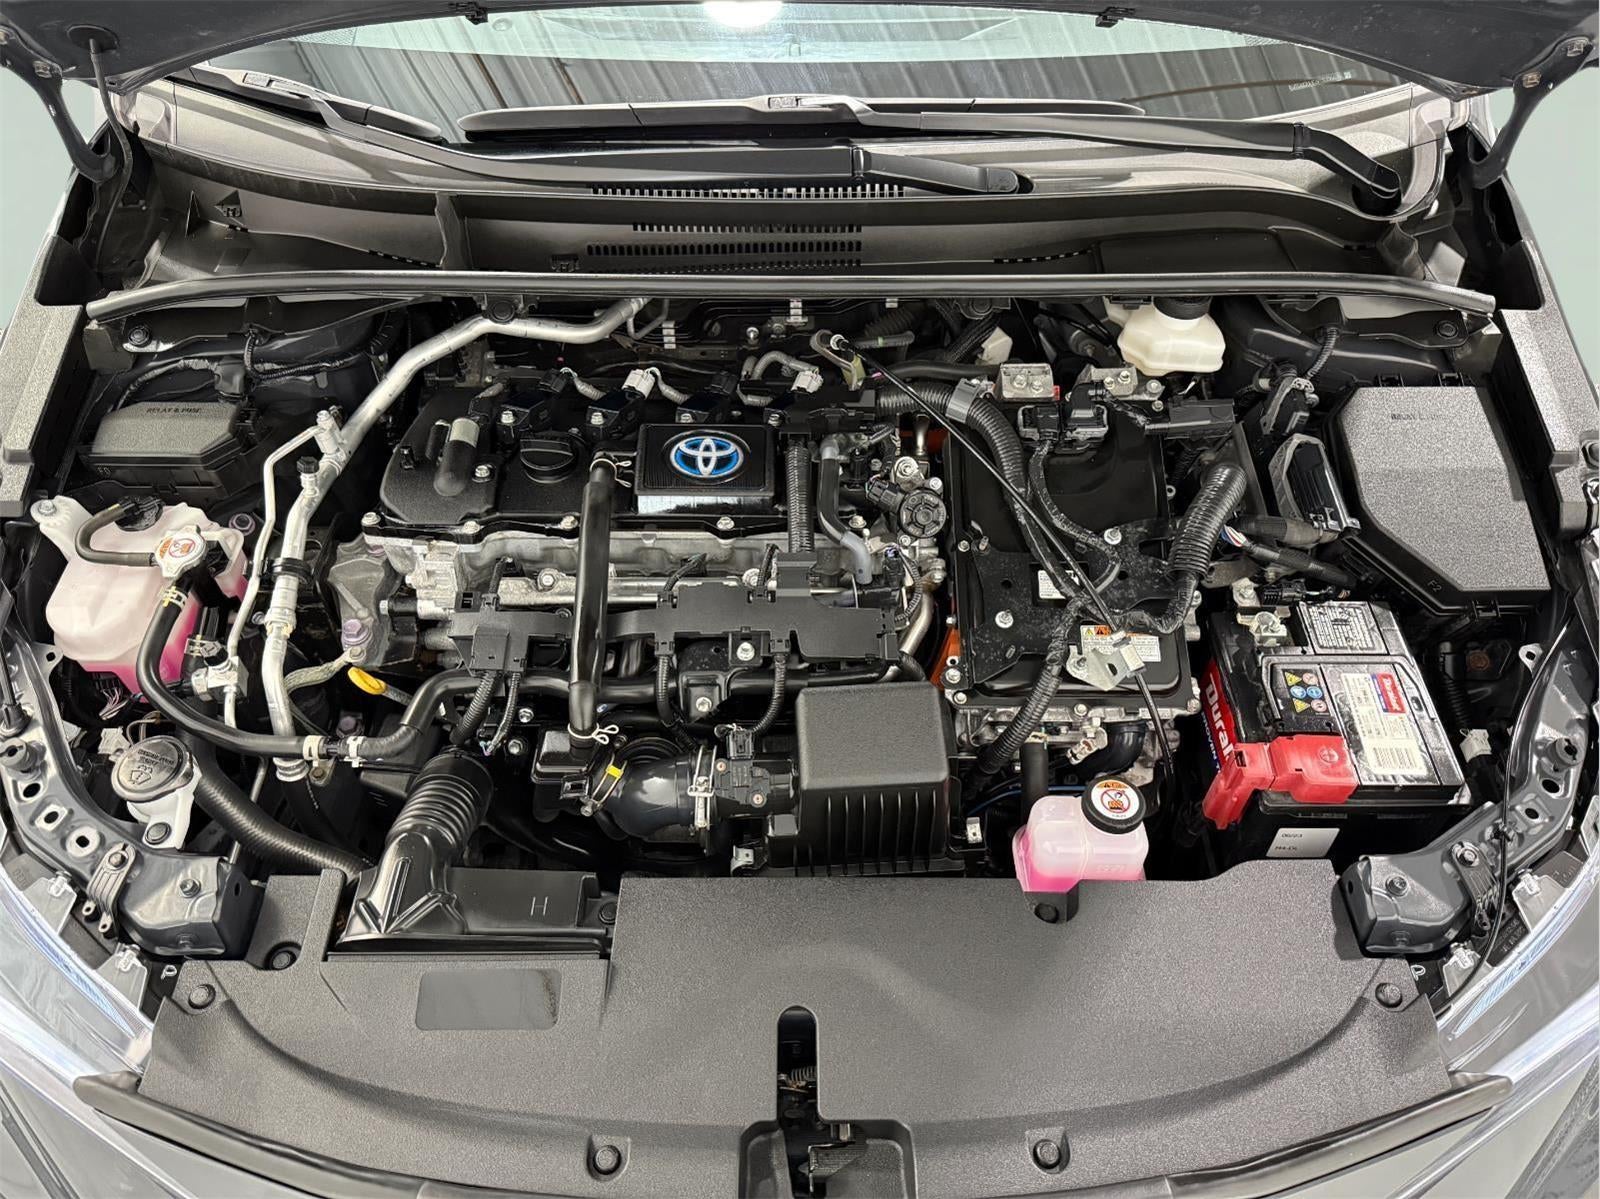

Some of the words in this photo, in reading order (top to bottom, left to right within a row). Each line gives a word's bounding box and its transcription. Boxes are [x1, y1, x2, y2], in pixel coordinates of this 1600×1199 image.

[1427, 579, 1442, 592] F2
[1205, 672, 1233, 761] Dural
[530, 896, 549, 916] H
